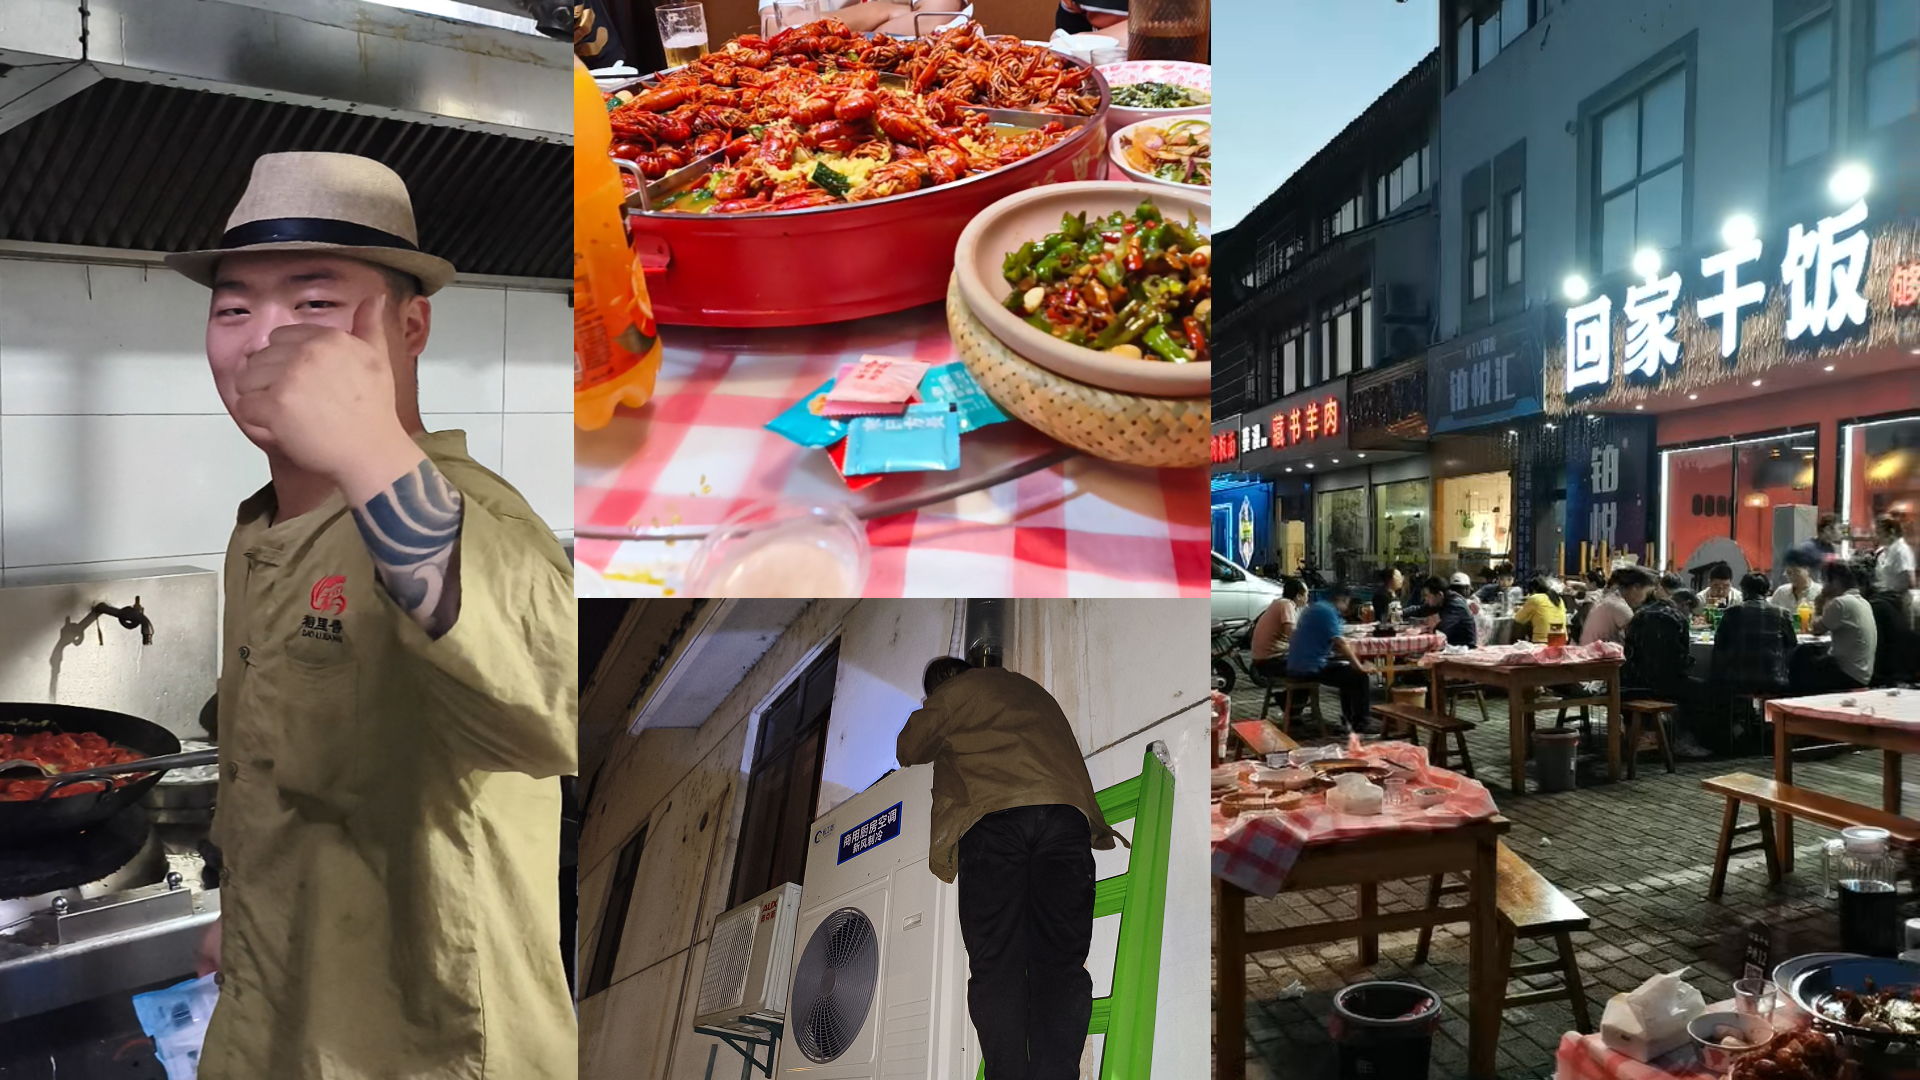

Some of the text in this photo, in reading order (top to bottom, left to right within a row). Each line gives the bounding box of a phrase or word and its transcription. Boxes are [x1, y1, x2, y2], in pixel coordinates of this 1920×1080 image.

[1565, 198, 1870, 394] 回家干饭
[1272, 396, 1338, 449] 藏书羊肉
[843, 808, 897, 848] 商用厨房空调
[852, 830, 884, 854] 新风制冷
